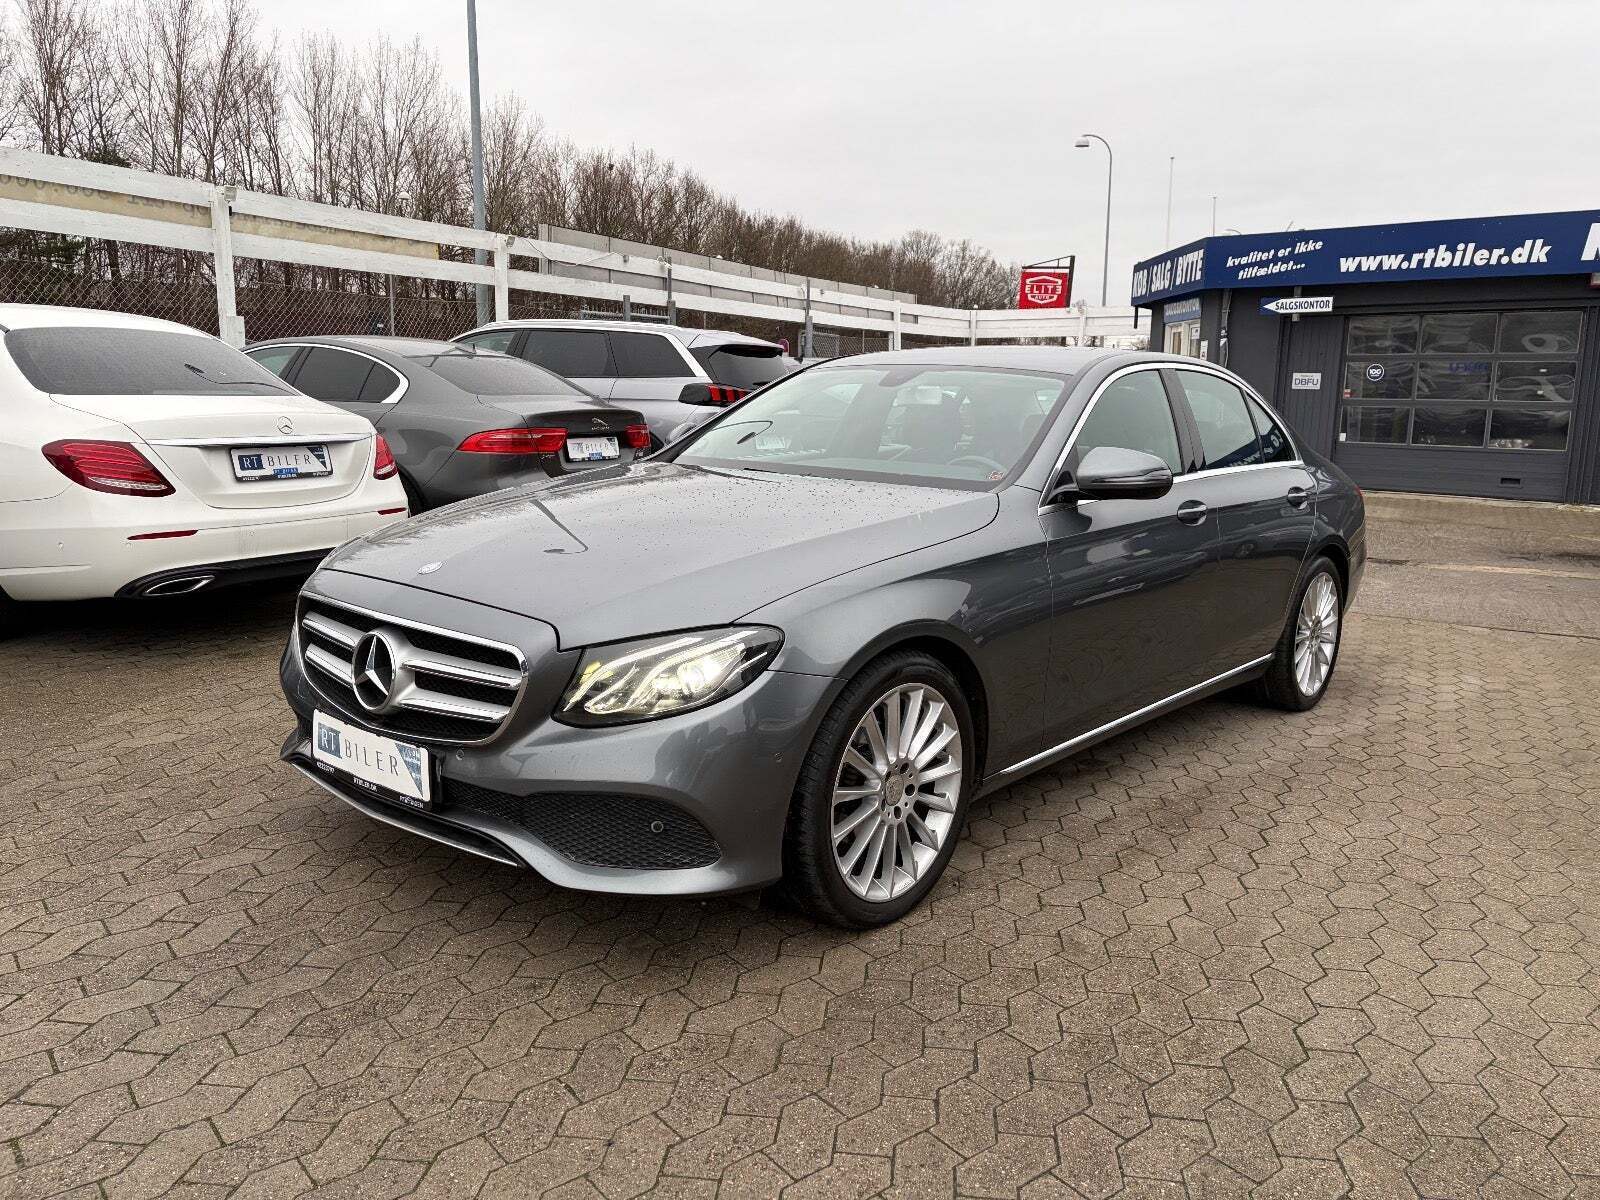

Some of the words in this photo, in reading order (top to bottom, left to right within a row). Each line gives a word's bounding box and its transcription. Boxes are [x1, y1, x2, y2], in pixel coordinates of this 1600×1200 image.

[1226, 248, 1275, 268] kvalitet
[1277, 247, 1292, 258] er
[1339, 238, 1552, 273] www.rtbiler.dk
[1151, 259, 1172, 293] SALG
[1175, 248, 1205, 286] BYTTE
[1025, 284, 1063, 295] ELITE
[1275, 299, 1330, 311] SALGSKONTOR
[1294, 377, 1319, 386] DBFU
[242, 456, 259, 469] RT
[267, 453, 312, 467] BILER
[320, 727, 337, 752] RT
[345, 738, 399, 777] BILER
